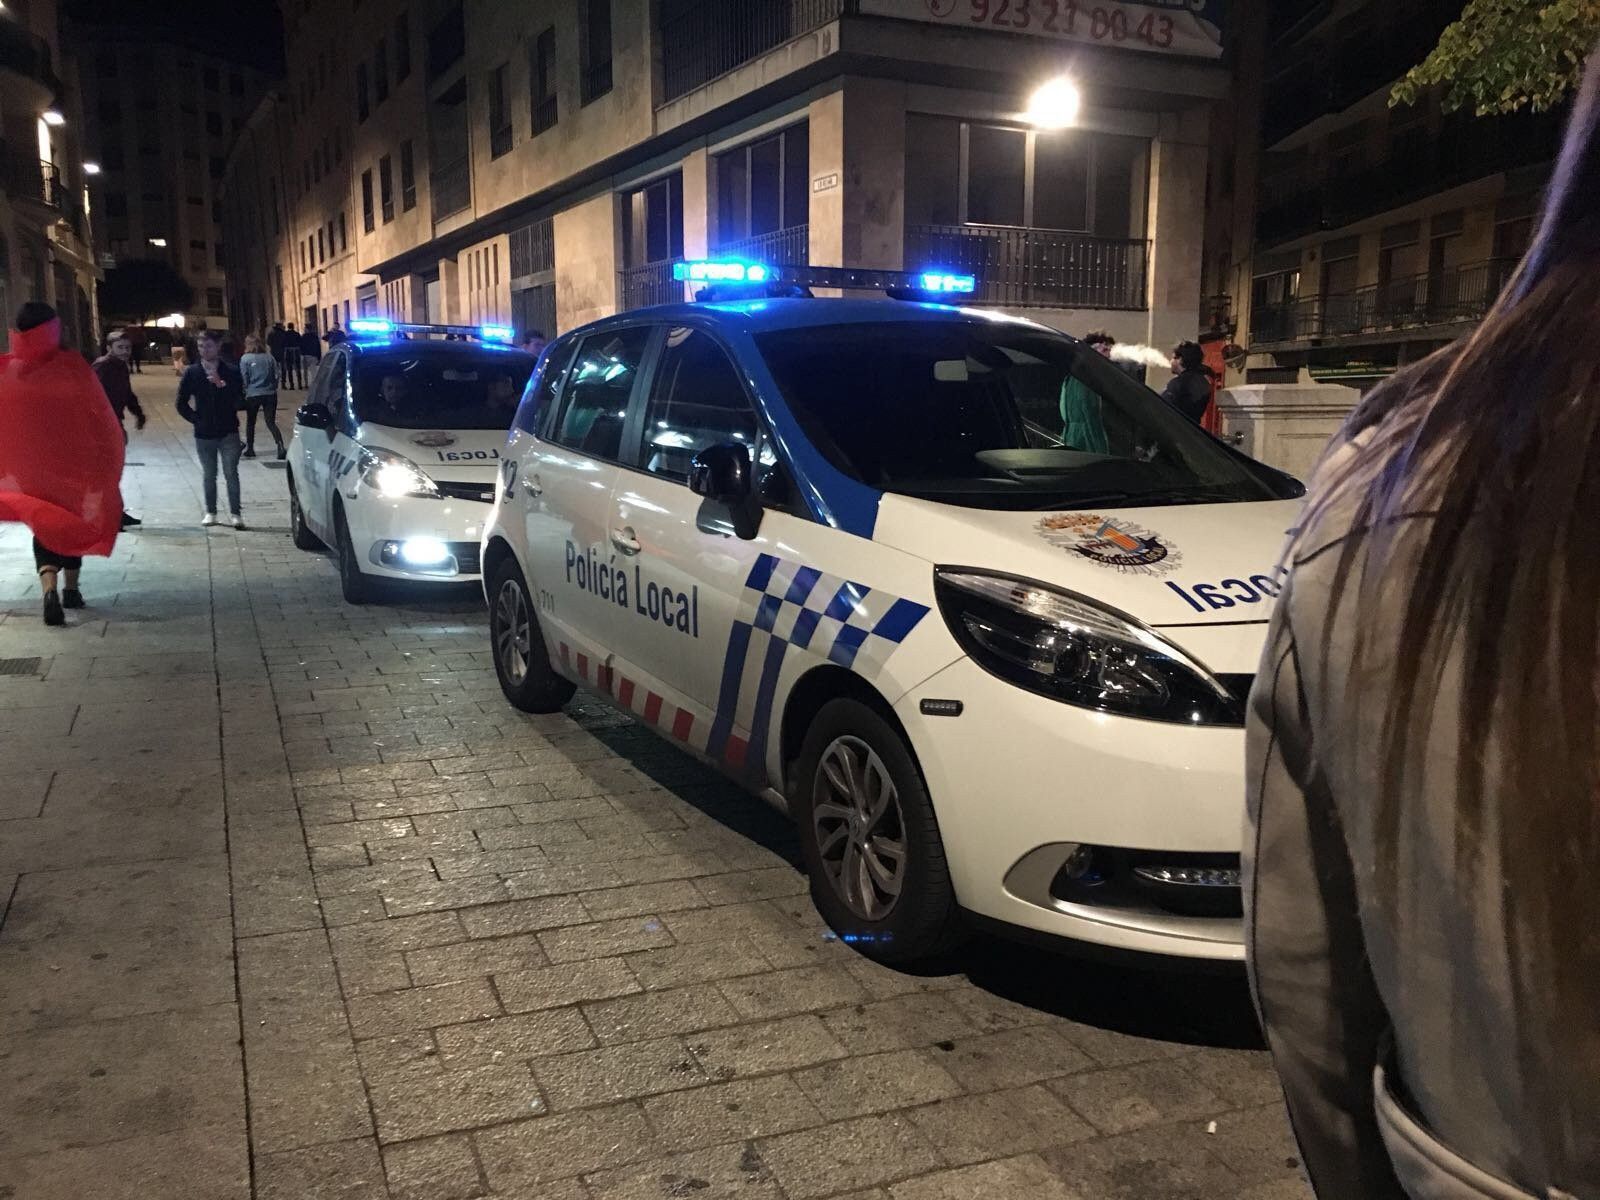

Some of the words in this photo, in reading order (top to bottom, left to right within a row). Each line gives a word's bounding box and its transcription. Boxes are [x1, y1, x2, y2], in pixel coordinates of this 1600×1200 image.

[969, 0, 1031, 28] 923
[1136, 13, 1174, 48] 43
[565, 539, 629, 609] Policía
[635, 564, 699, 639] Local
